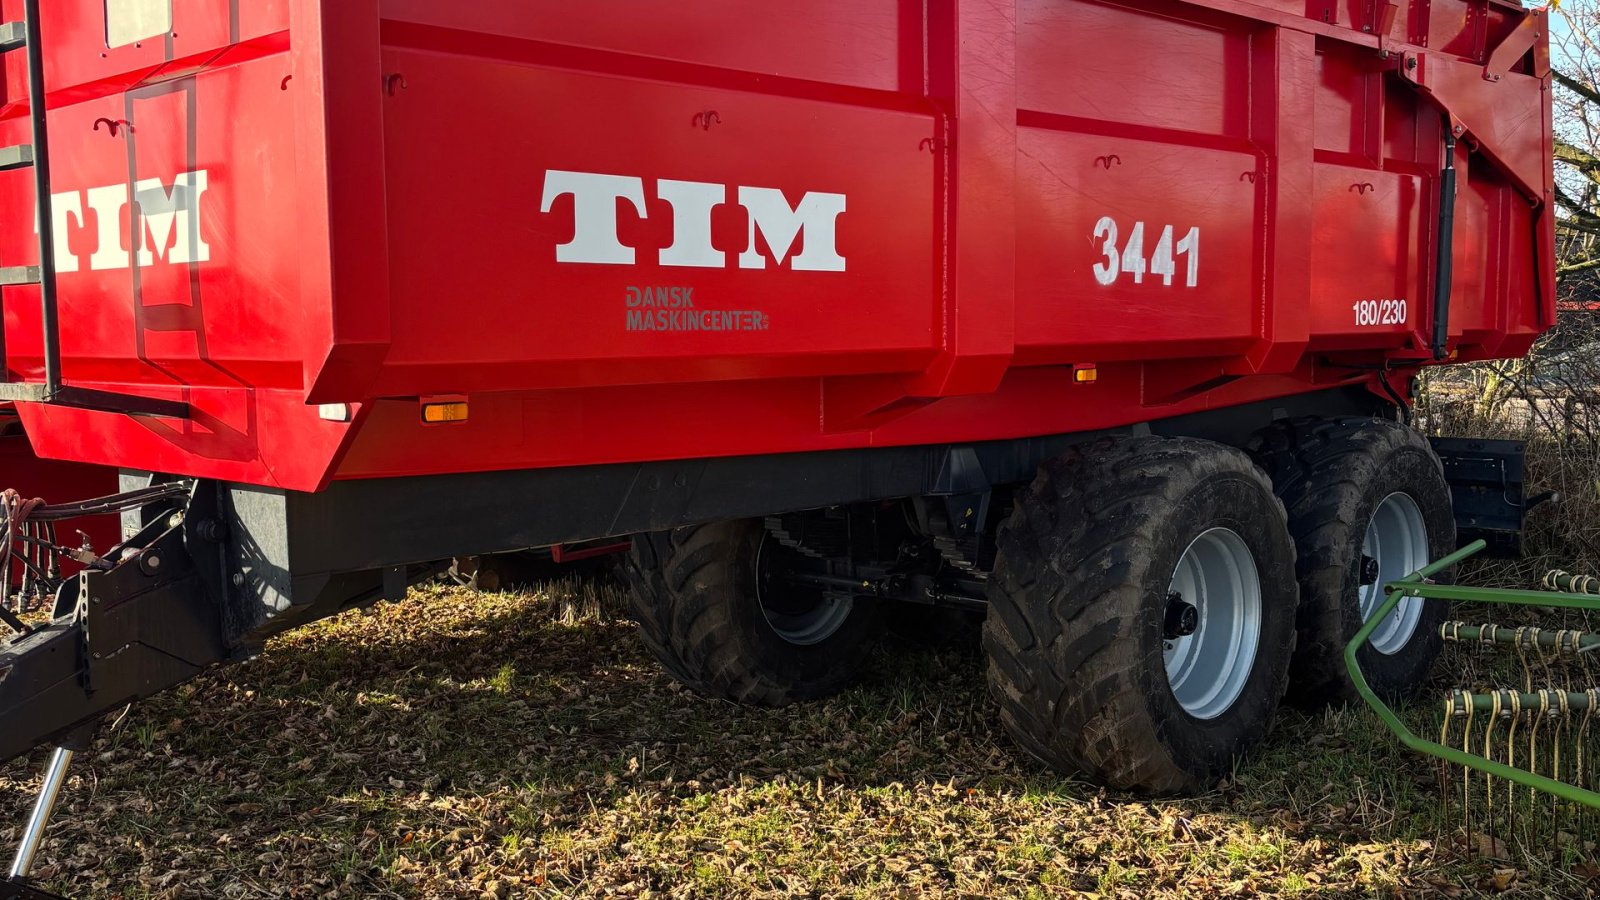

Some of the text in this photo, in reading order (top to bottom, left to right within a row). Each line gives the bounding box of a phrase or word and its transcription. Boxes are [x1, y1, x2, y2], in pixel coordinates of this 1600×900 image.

[34, 170, 210, 273] TIM
[540, 169, 846, 272] TIM
[1092, 216, 1200, 287] 3441
[625, 286, 694, 308] DANSK
[625, 309, 763, 331] MASKINCENTER
[1352, 299, 1407, 326] 180/230
